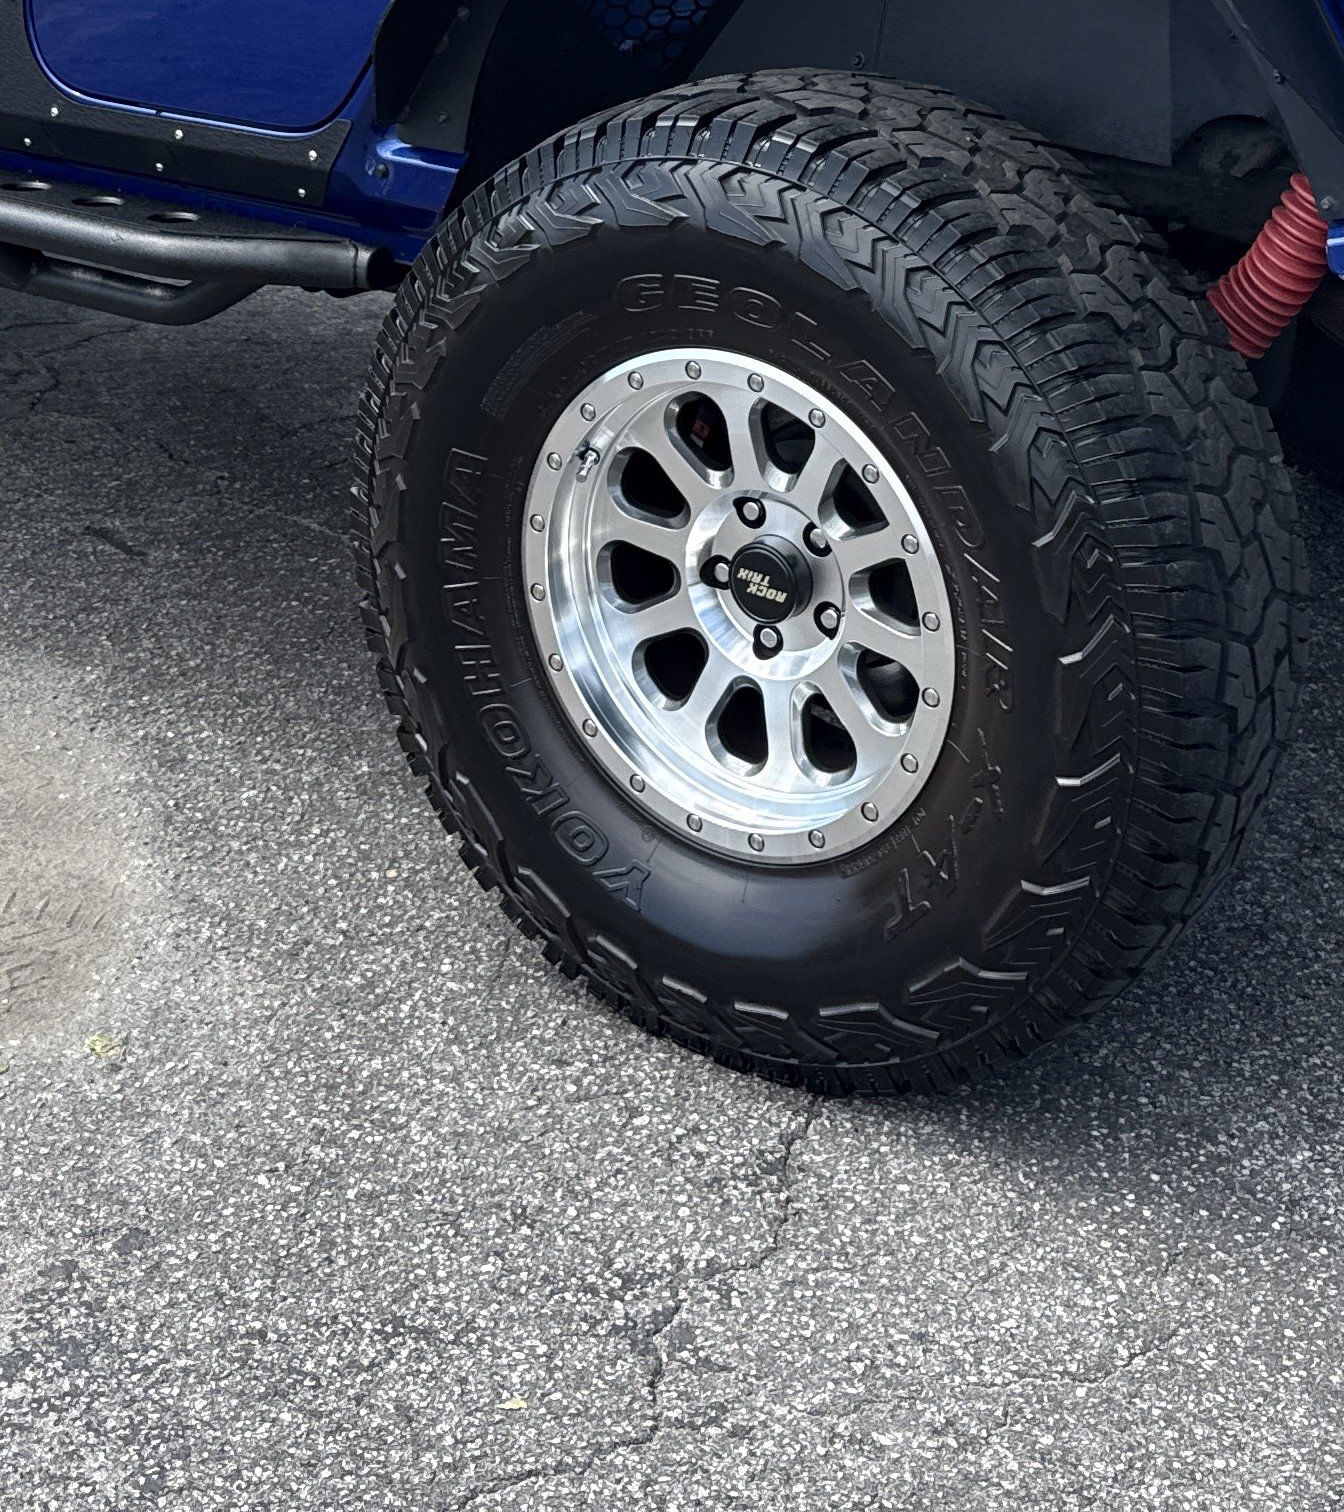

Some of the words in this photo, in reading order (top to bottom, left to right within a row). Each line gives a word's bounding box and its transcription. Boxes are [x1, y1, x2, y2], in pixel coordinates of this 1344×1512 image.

[615, 273, 1016, 715] GEOLANDAR
[736, 567, 771, 587] TRIX
[746, 582, 788, 603] ROCK
[438, 446, 652, 912] YOKOHAMA
